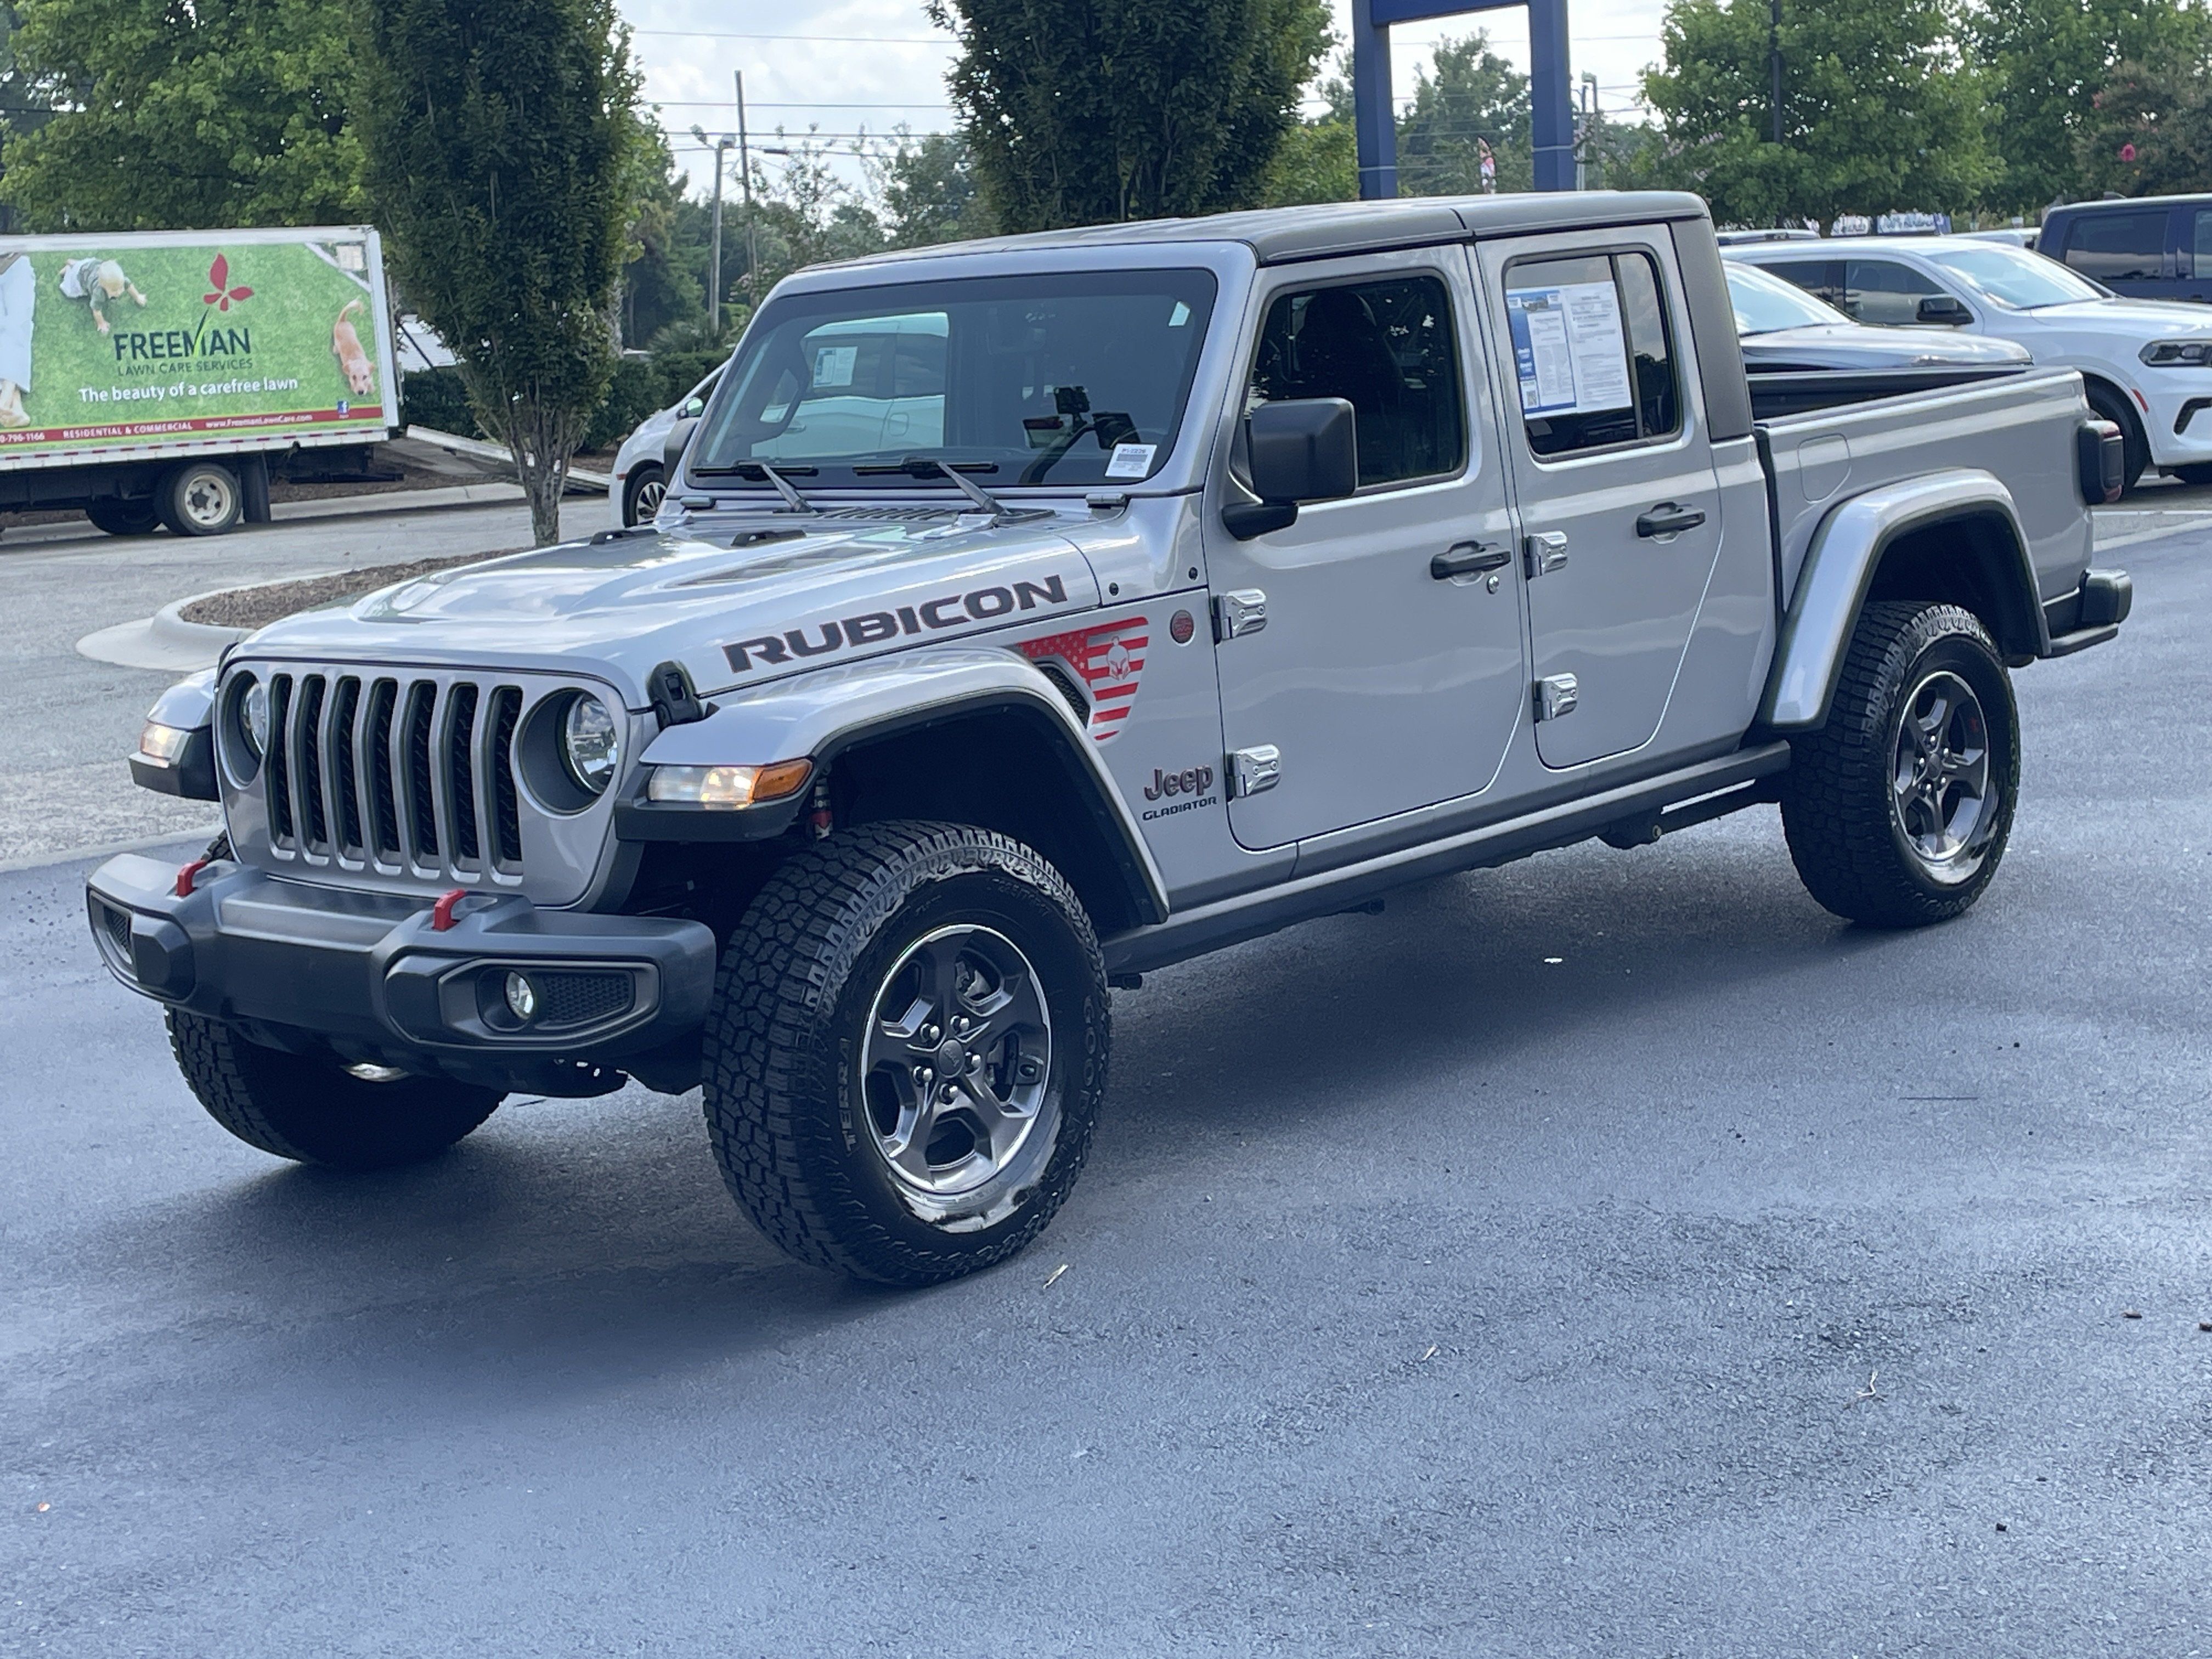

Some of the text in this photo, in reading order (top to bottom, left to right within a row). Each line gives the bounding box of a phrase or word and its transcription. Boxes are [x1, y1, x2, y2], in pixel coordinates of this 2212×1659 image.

[114, 328, 251, 360] FREEMAN
[117, 358, 253, 376] LAWN CARE SERVICES
[78, 377, 298, 402] The beauty of a carefree lawn
[63, 427, 122, 439] RESIDENTIAL
[125, 426, 131, 435] &
[133, 422, 193, 435] COMMERCIAL
[722, 574, 1068, 674] RUBICON
[1144, 765, 1214, 801] Jeep
[1142, 796, 1217, 821] GLADIATOR
